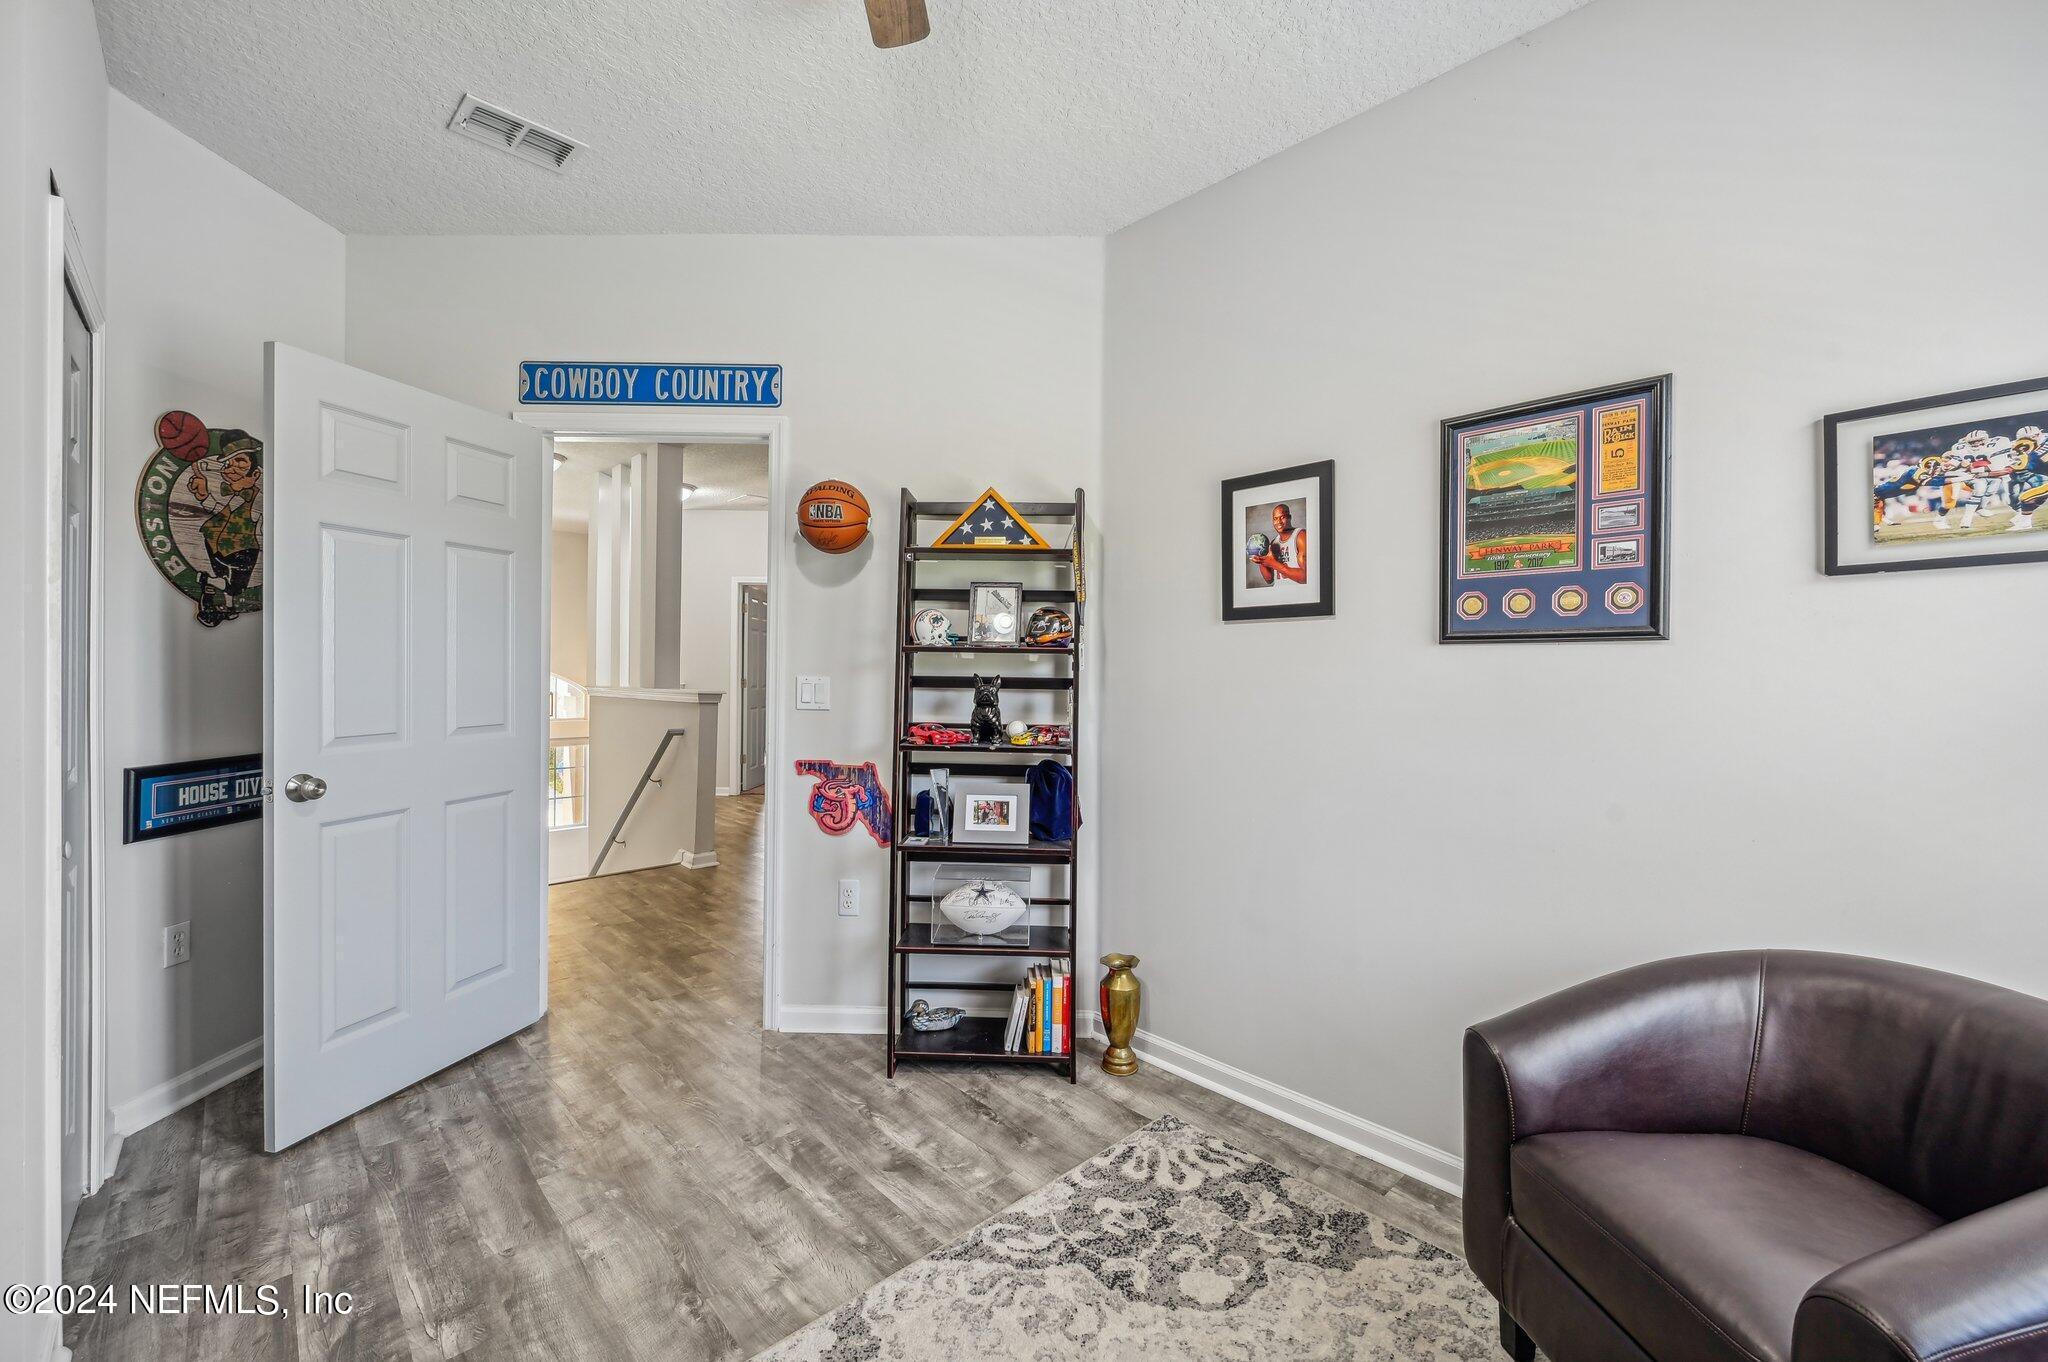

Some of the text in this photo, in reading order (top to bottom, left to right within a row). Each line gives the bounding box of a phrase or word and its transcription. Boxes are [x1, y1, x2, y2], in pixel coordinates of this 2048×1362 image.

[534, 367, 768, 402] COWBOY COUNTRY
[145, 456, 188, 578] BOSTON
[816, 504, 843, 519] NBA
[1485, 541, 1555, 554] FENWAY PARK
[1494, 557, 1544, 571] 1912 2012
[178, 776, 263, 807] HOUSE DIV
